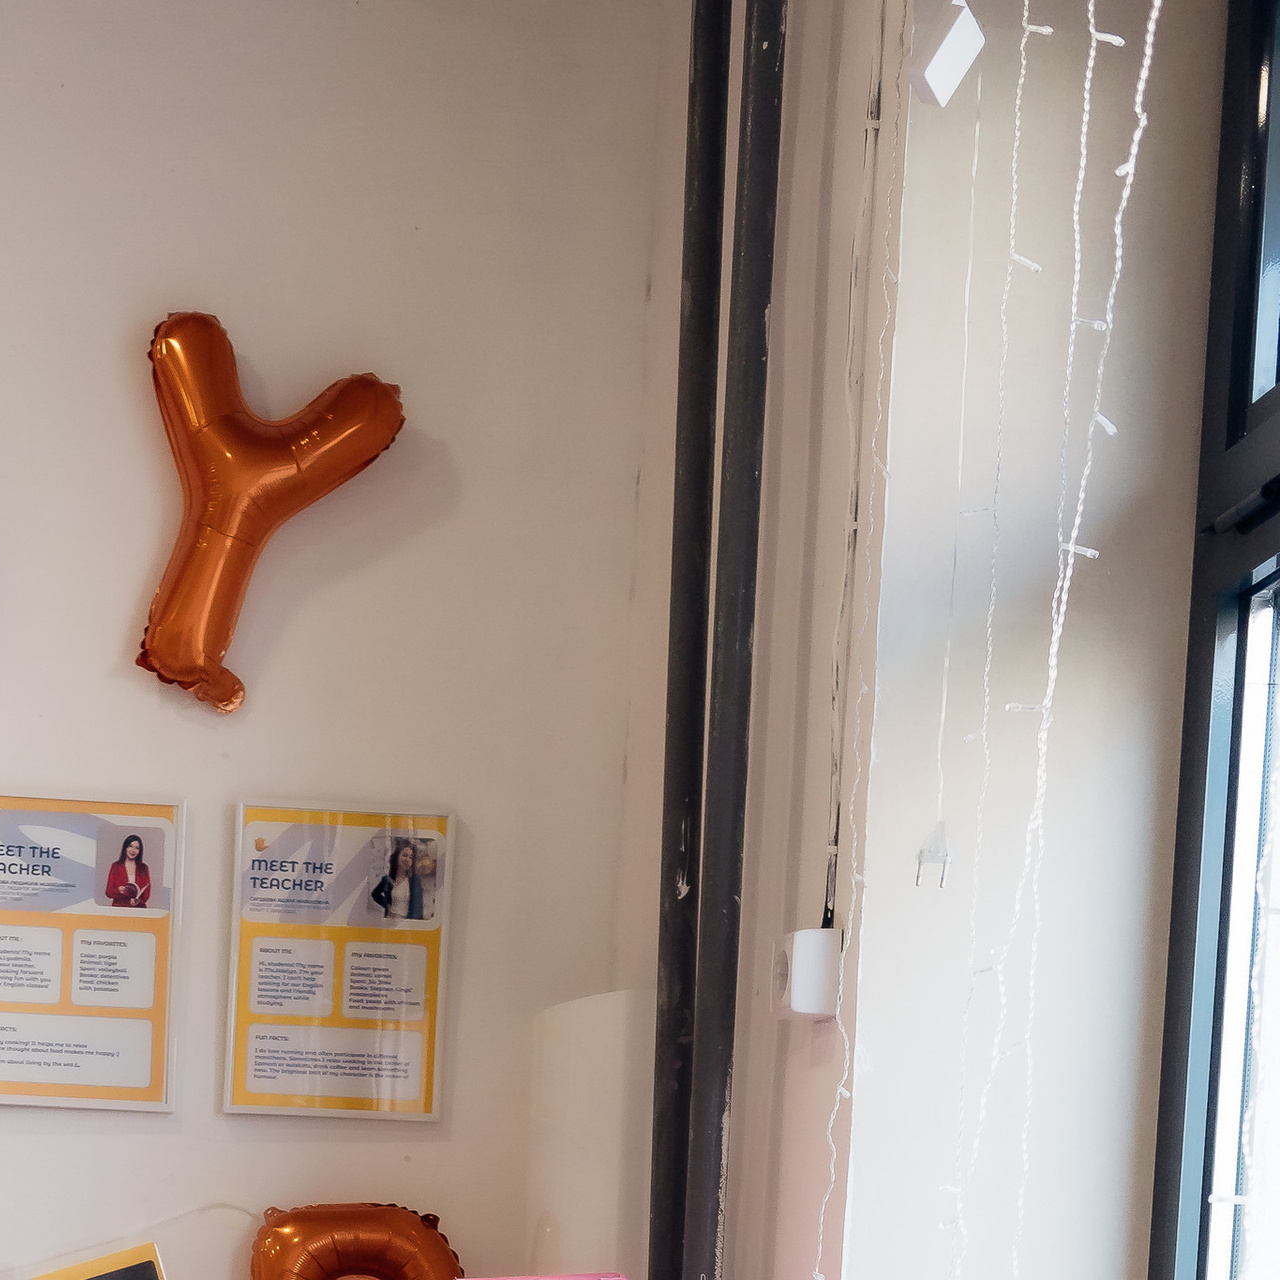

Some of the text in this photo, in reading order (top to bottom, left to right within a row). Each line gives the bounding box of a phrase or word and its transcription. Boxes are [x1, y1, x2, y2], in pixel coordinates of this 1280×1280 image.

[29, 845, 61, 860] THE
[251, 858, 334, 875] MEET THE
[250, 876, 324, 893] TEACHER
